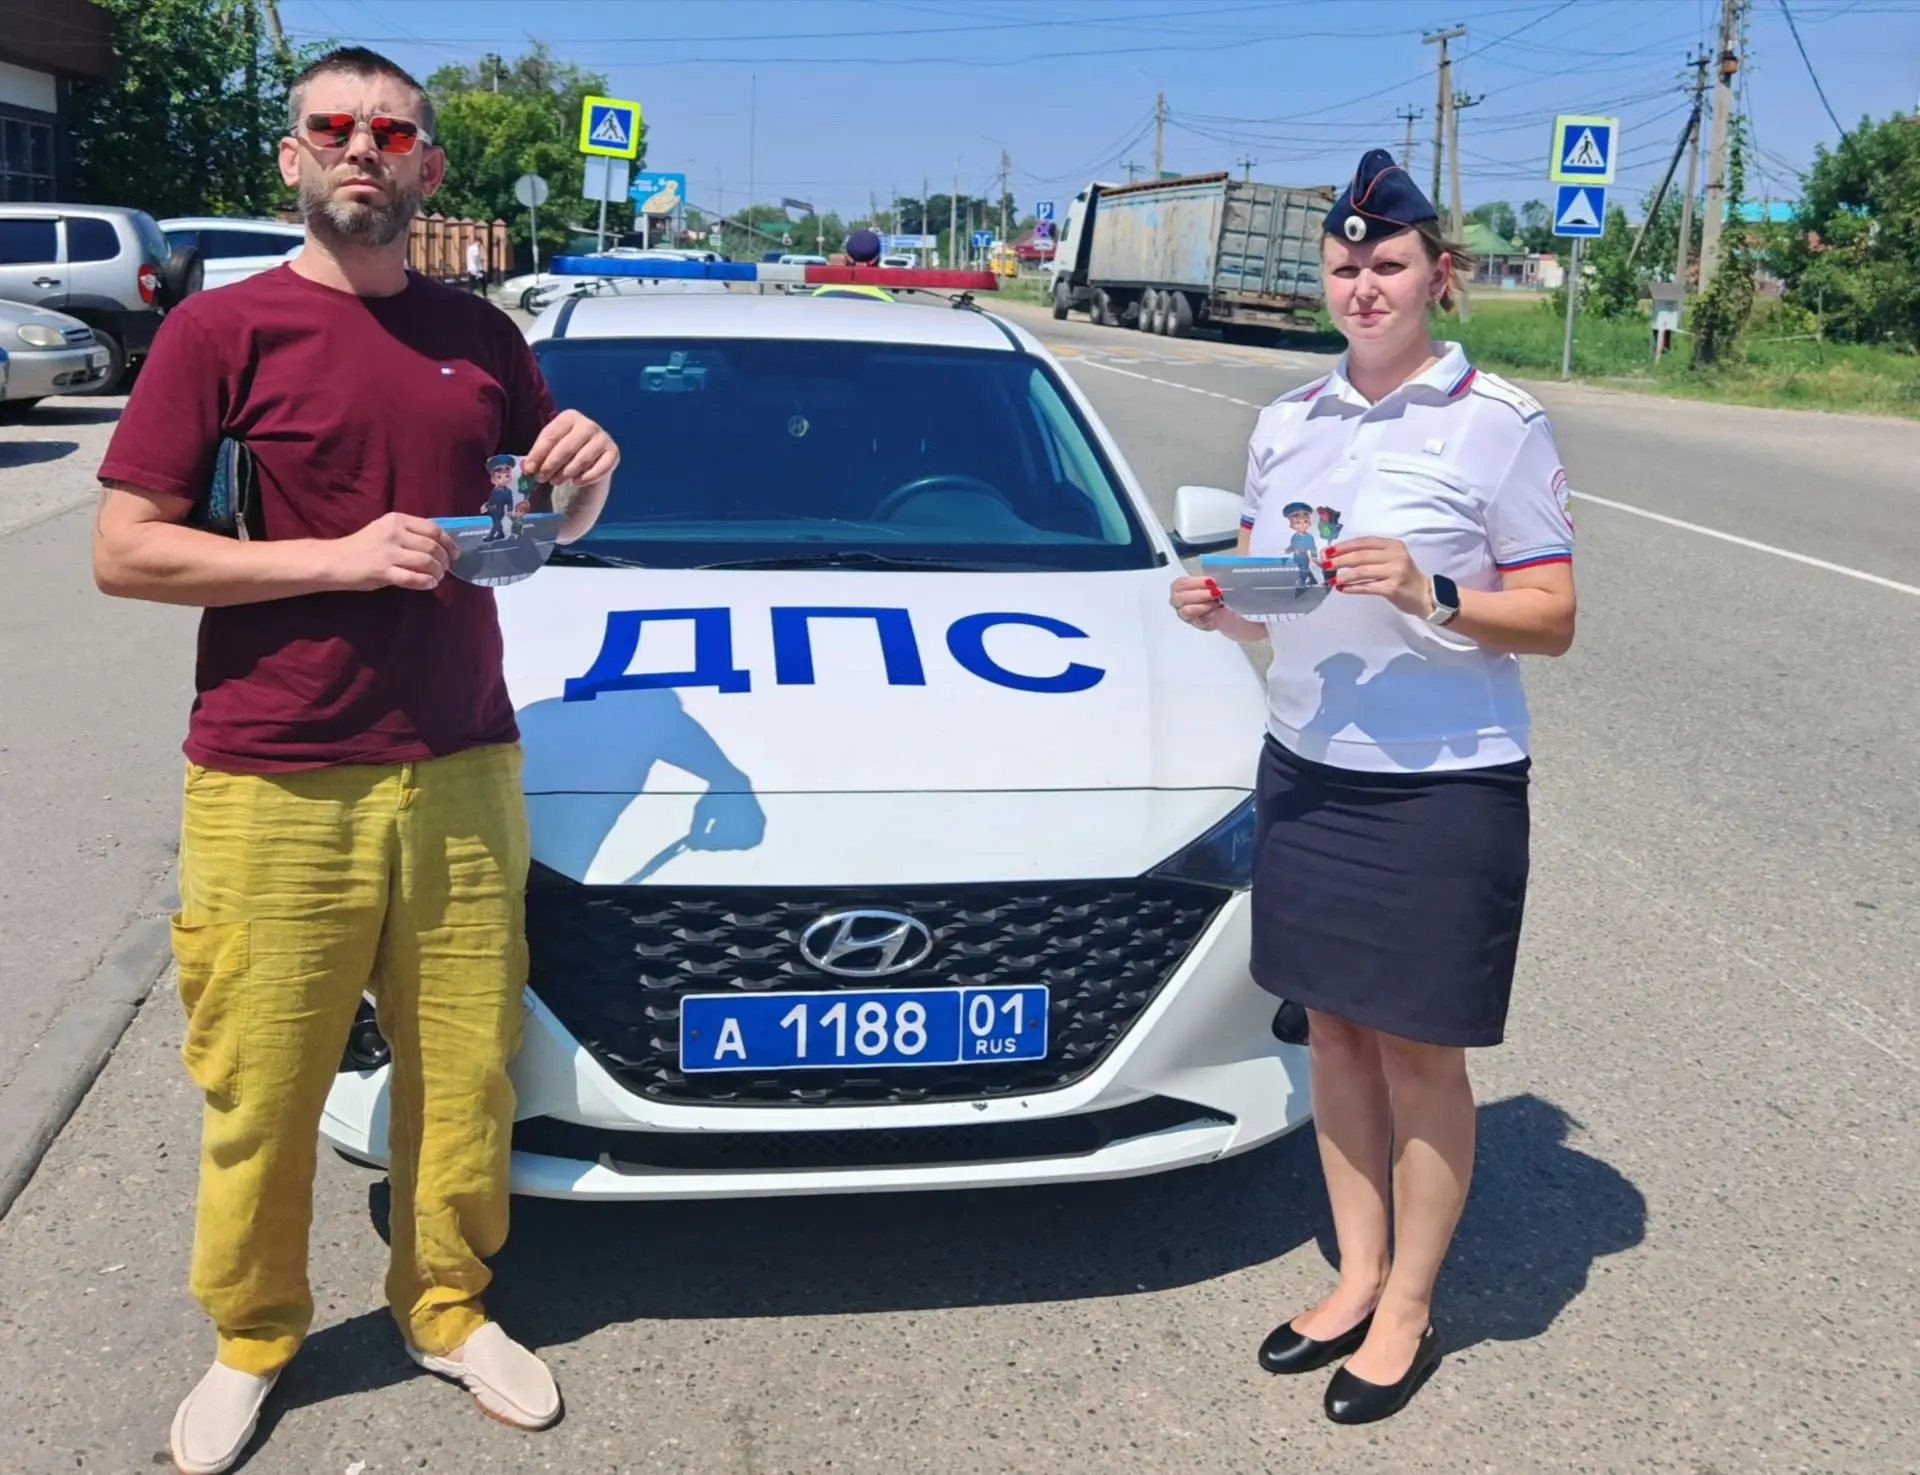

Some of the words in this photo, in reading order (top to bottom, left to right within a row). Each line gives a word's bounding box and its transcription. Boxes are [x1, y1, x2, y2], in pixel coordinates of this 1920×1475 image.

[563, 606, 1106, 702] ДПС
[779, 1001, 927, 1058] 1188
[968, 993, 1024, 1036] 01
[975, 1038, 1016, 1055] RUS
